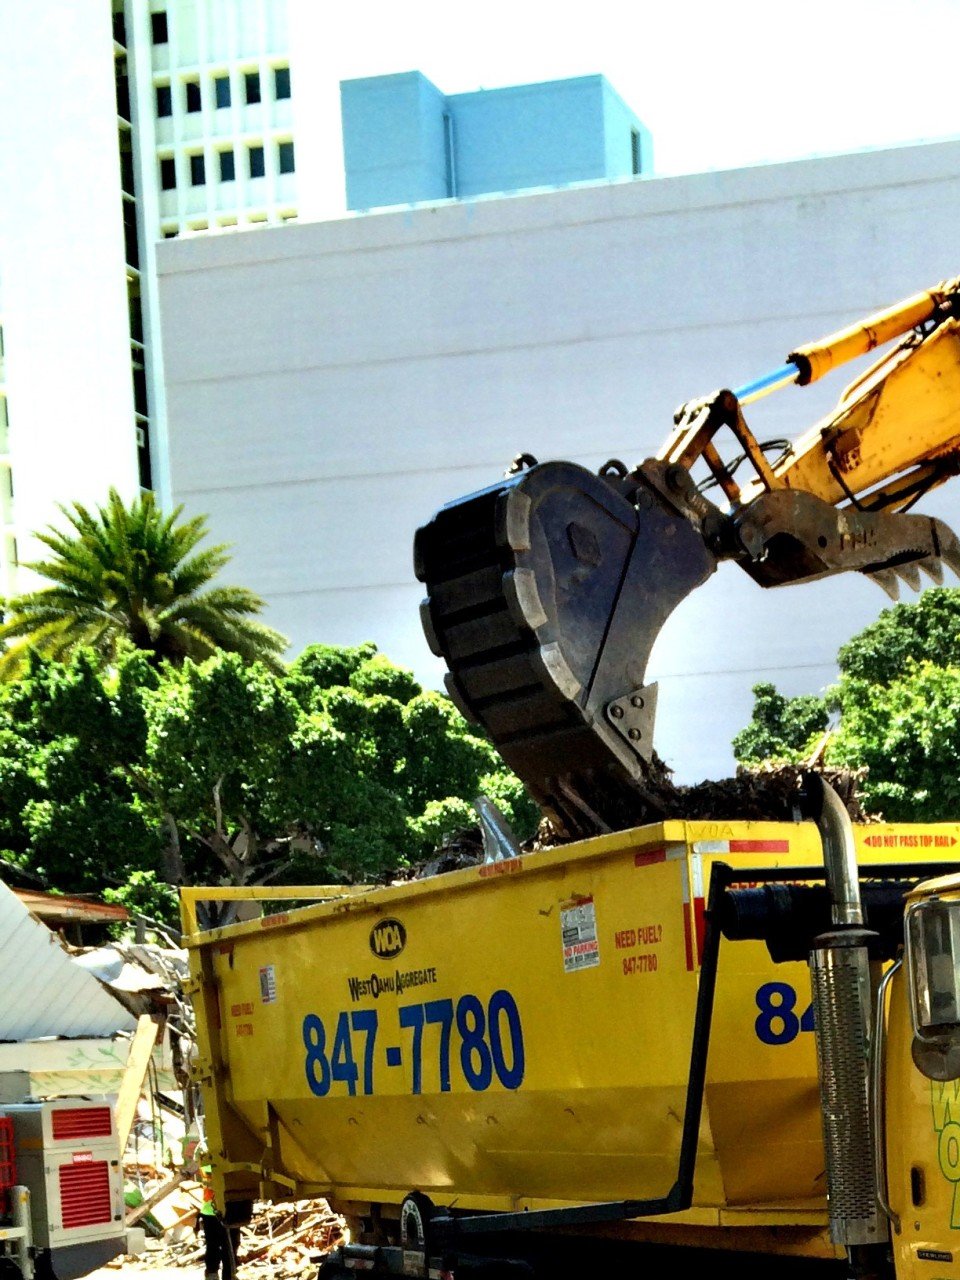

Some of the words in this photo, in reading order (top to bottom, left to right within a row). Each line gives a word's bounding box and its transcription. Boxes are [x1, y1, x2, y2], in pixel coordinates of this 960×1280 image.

[872, 836, 882, 847] DO
[884, 836, 898, 847] NOT
[900, 836, 918, 847] PASS
[920, 836, 933, 847] TOP
[935, 836, 949, 847] RAIL
[373, 924, 403, 954] WOA
[614, 929, 636, 949] NEED
[637, 924, 663, 946] FUEL?
[564, 947, 573, 958] NO
[622, 953, 658, 975] 847-7780
[395, 967, 438, 996] AGGREGATE
[754, 982, 815, 1045] 8
[302, 989, 525, 1097] 847-7780
